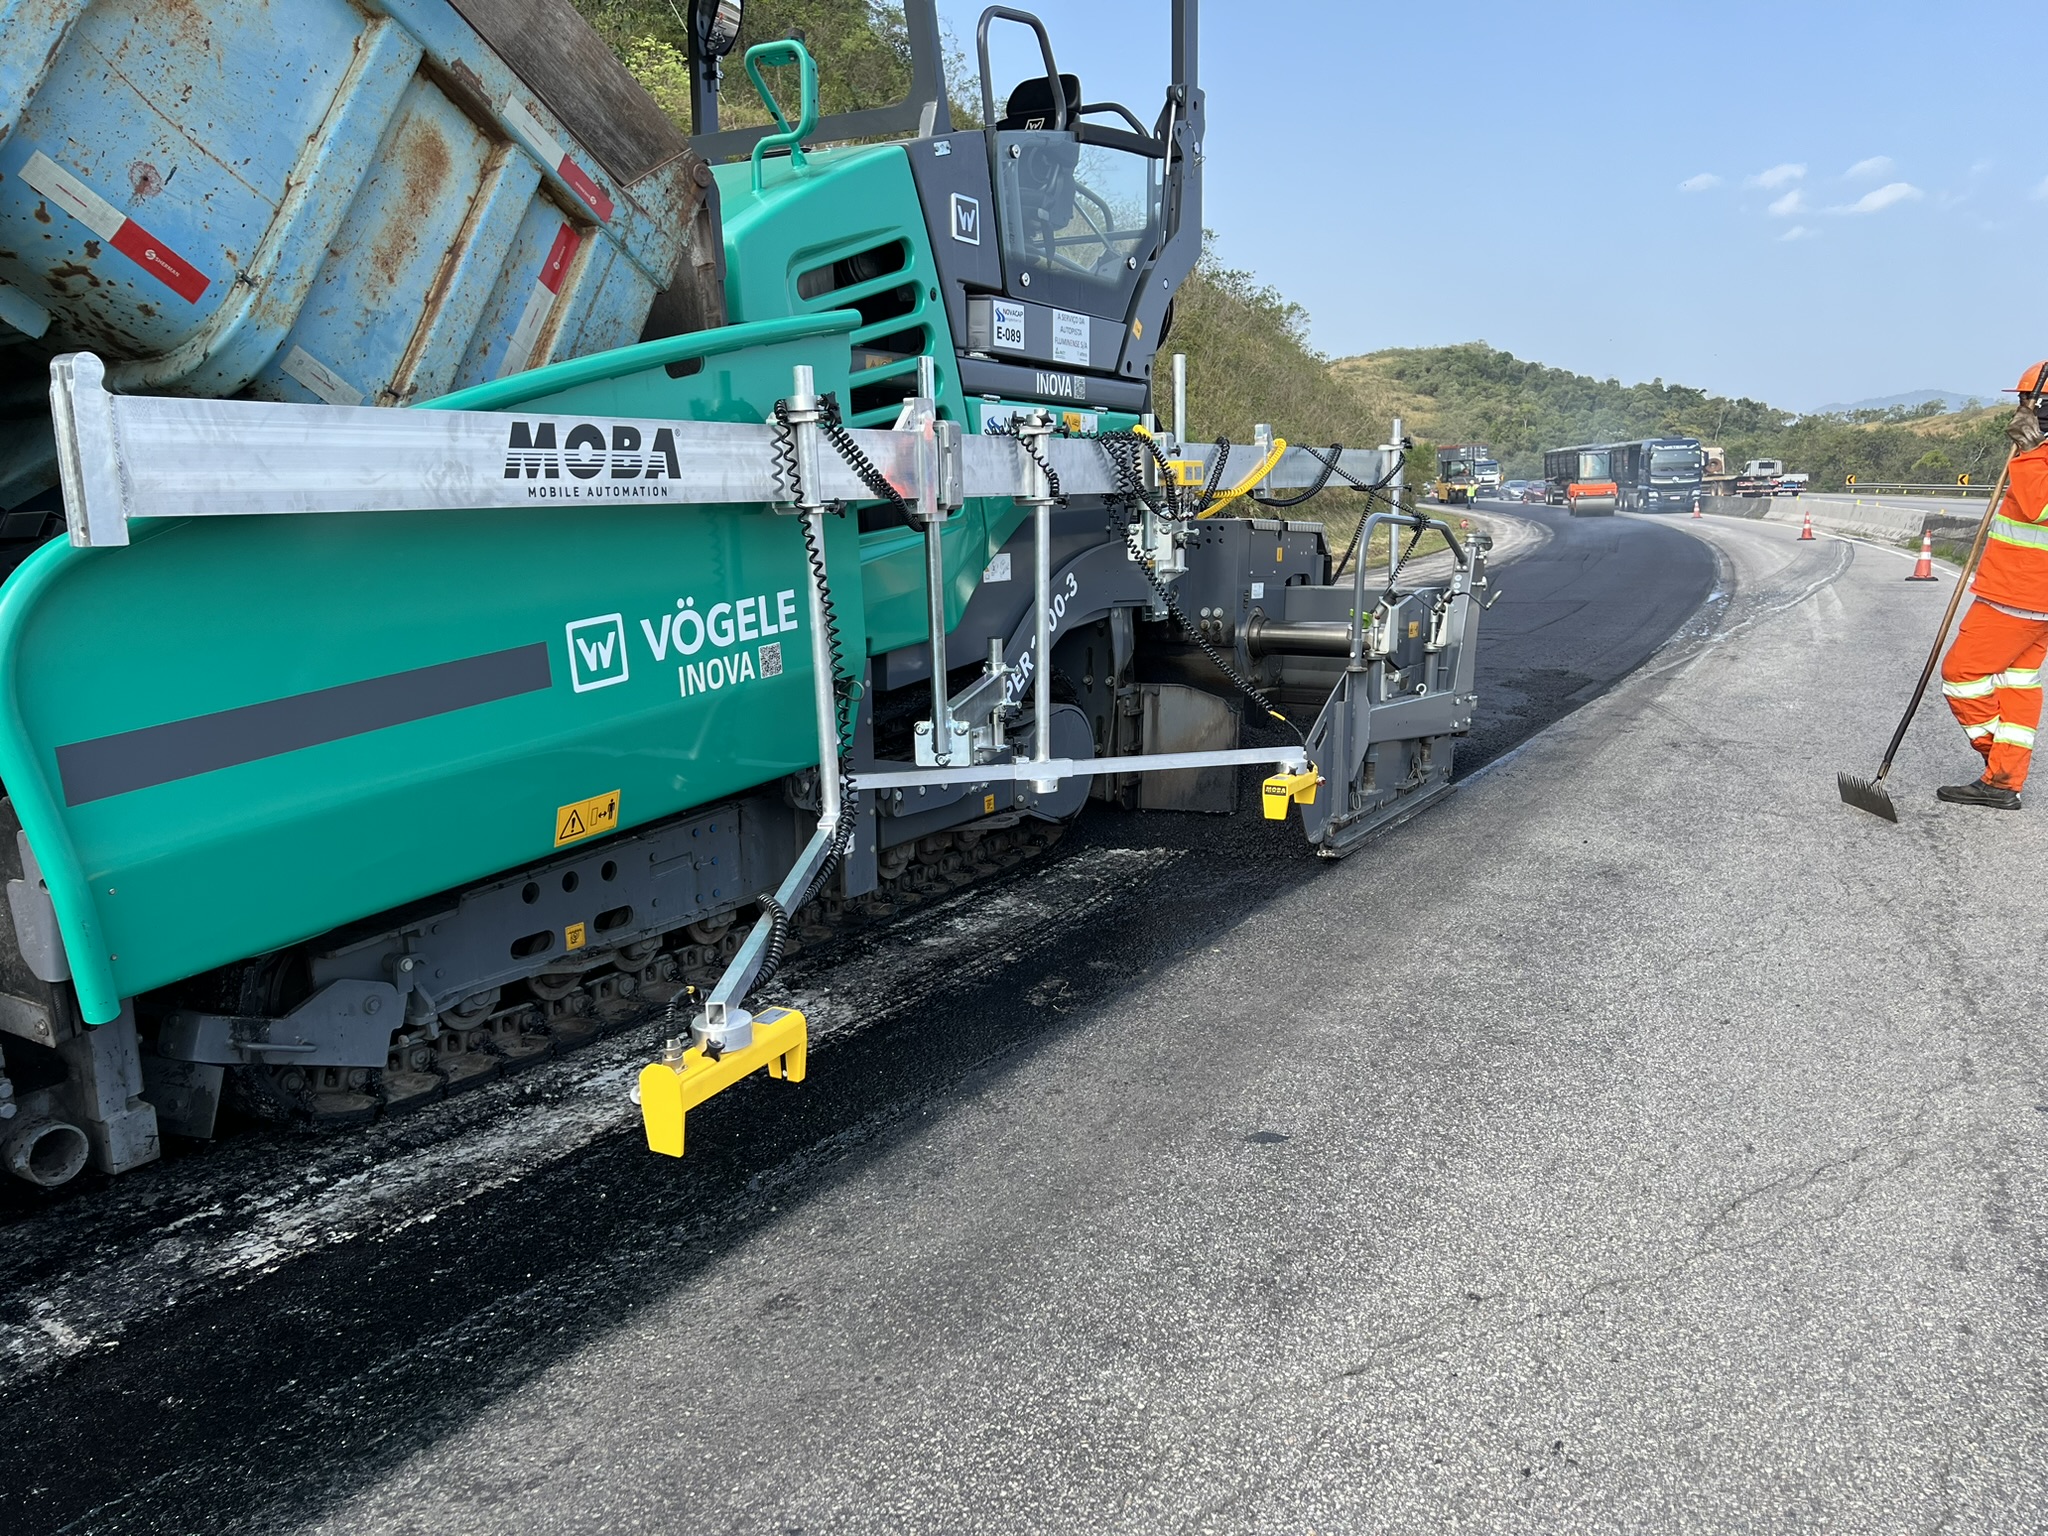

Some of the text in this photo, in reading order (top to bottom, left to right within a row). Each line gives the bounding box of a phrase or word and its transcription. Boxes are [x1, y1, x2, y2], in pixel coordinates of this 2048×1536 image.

[155, 256, 180, 277] SHERMAN
[1002, 307, 1024, 318] NOVACAP
[997, 325, 1021, 343] E-089
[1036, 372, 1072, 397] INOVA
[528, 486, 669, 498] MOBILE AUTOMATION
[639, 588, 799, 662] VÖGELE
[678, 650, 756, 698] INOVA
